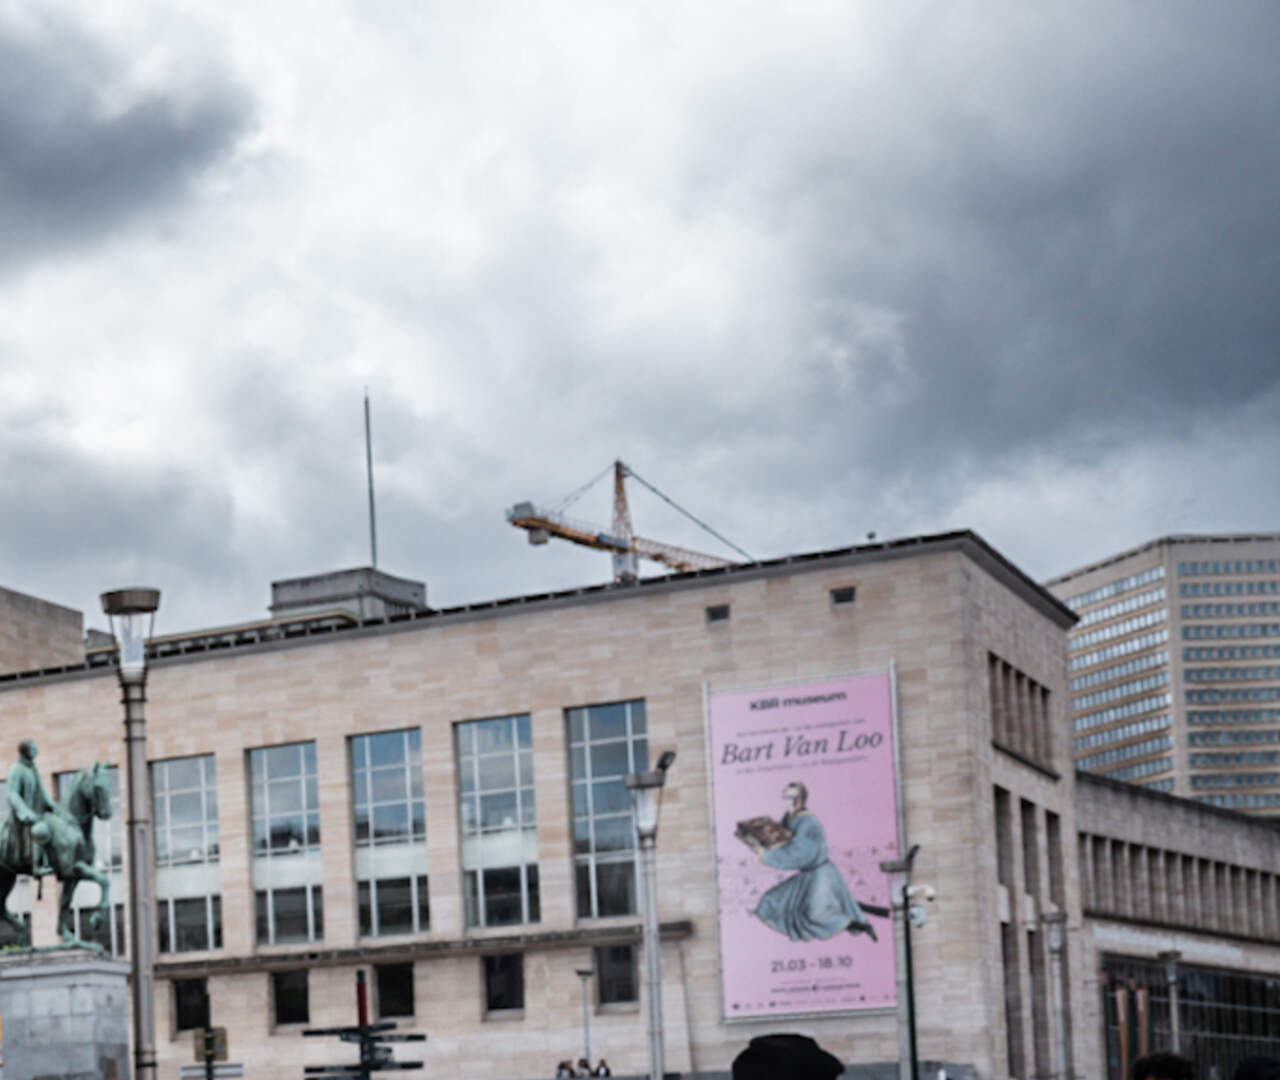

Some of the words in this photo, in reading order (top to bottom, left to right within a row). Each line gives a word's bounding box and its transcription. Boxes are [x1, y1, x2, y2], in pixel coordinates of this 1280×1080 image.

[782, 691, 848, 707] museum
[721, 741, 774, 766] Bart
[783, 734, 829, 758] Van
[836, 729, 884, 753] Loo
[770, 959, 807, 973] 21.03
[817, 955, 853, 971] 18.10
